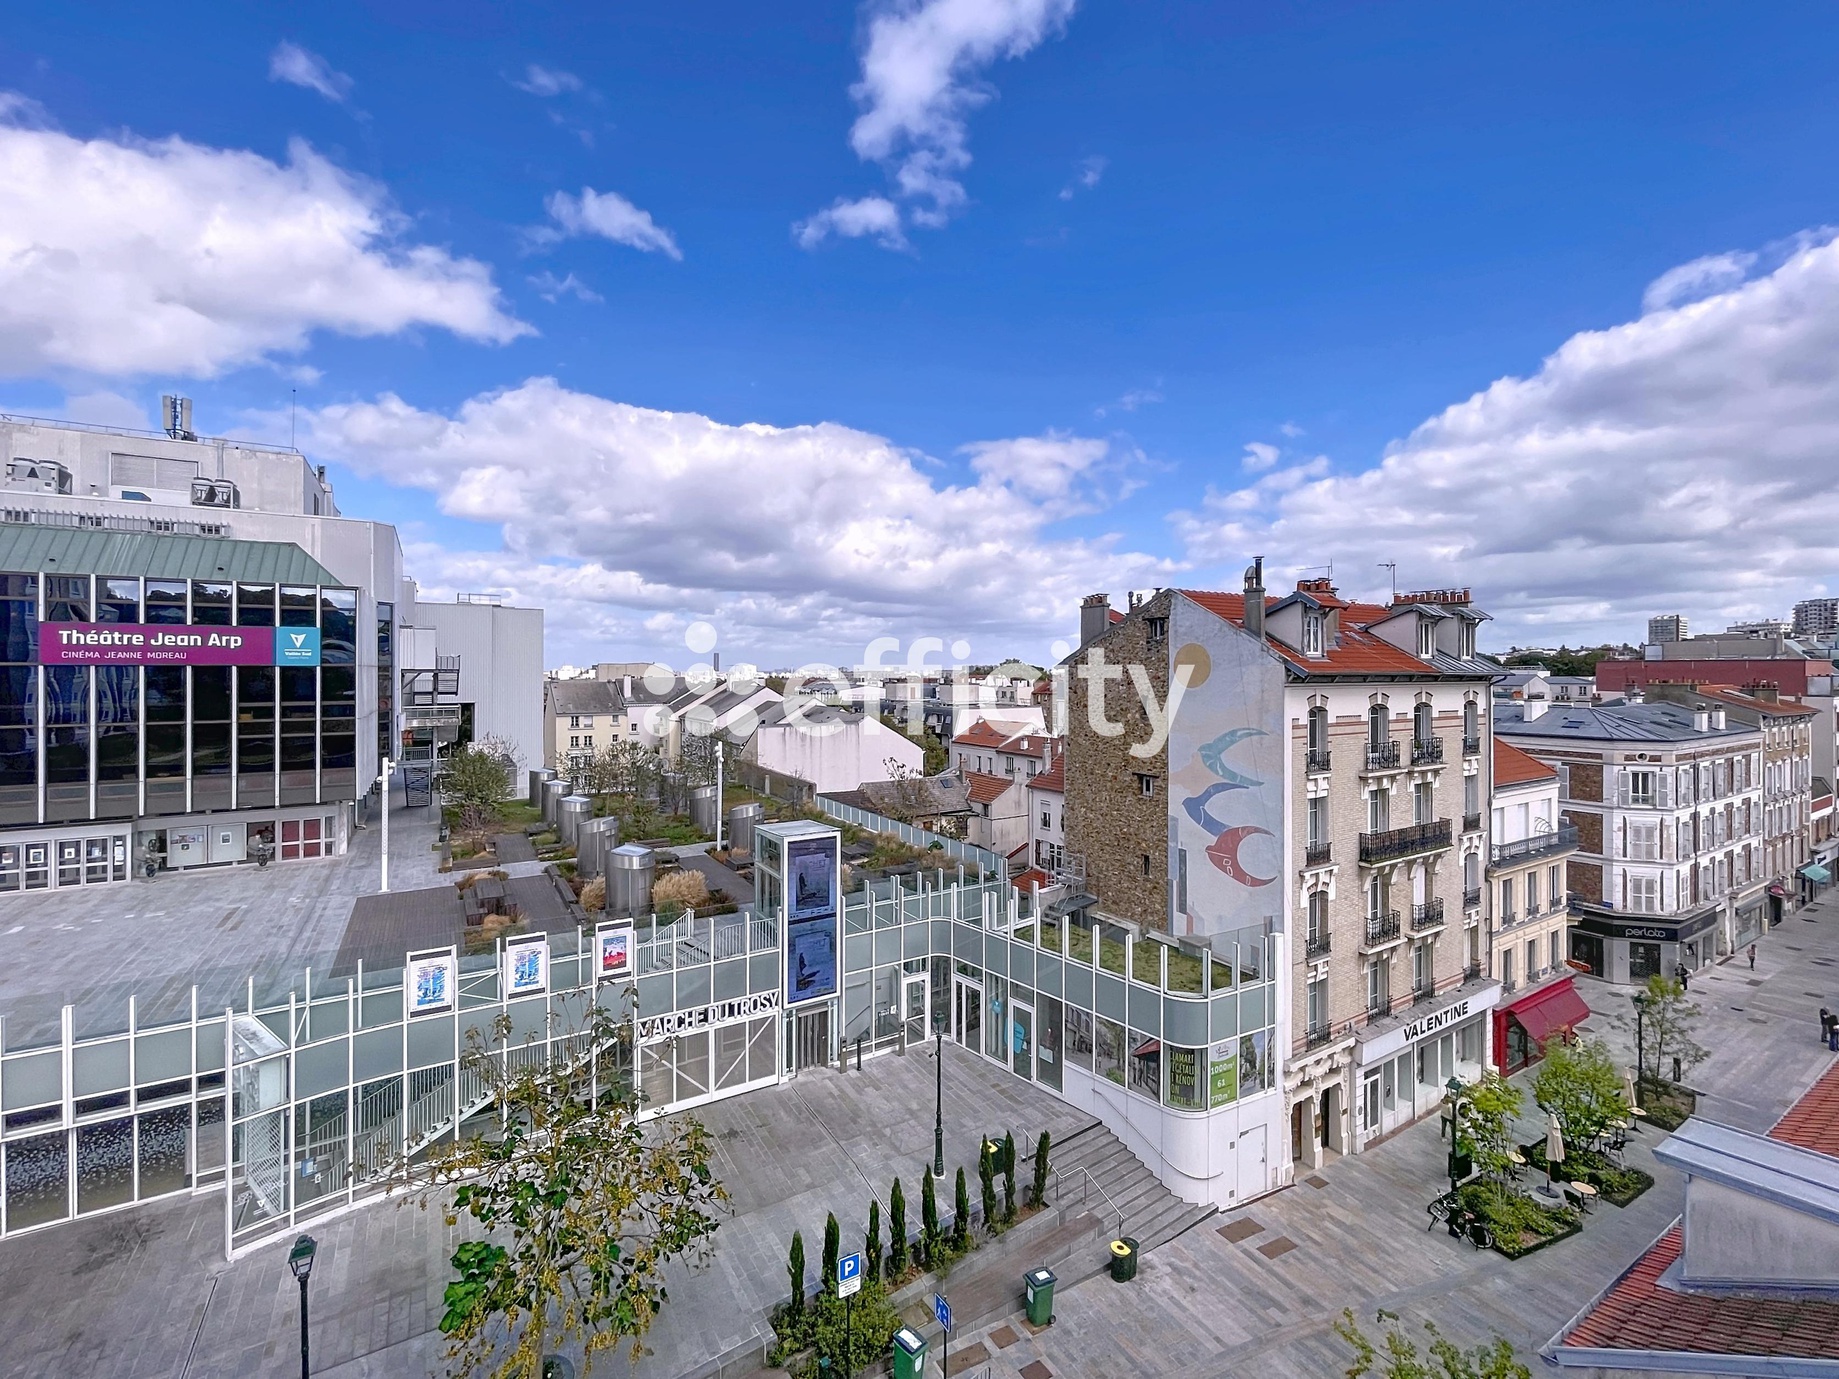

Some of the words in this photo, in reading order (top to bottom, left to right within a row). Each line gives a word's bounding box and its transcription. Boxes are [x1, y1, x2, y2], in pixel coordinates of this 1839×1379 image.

[58, 629, 144, 645] Théâtre
[150, 632, 202, 646] Jean
[207, 633, 242, 649] Arp
[61, 650, 100, 659] CINÉMA
[104, 651, 142, 659] JEANNE
[707, 1004, 729, 1025] DU
[730, 991, 779, 1018] TROSY
[1403, 1001, 1469, 1041] VALENTINE
[1217, 1079, 1226, 1088] 61
[844, 1260, 854, 1276] P
